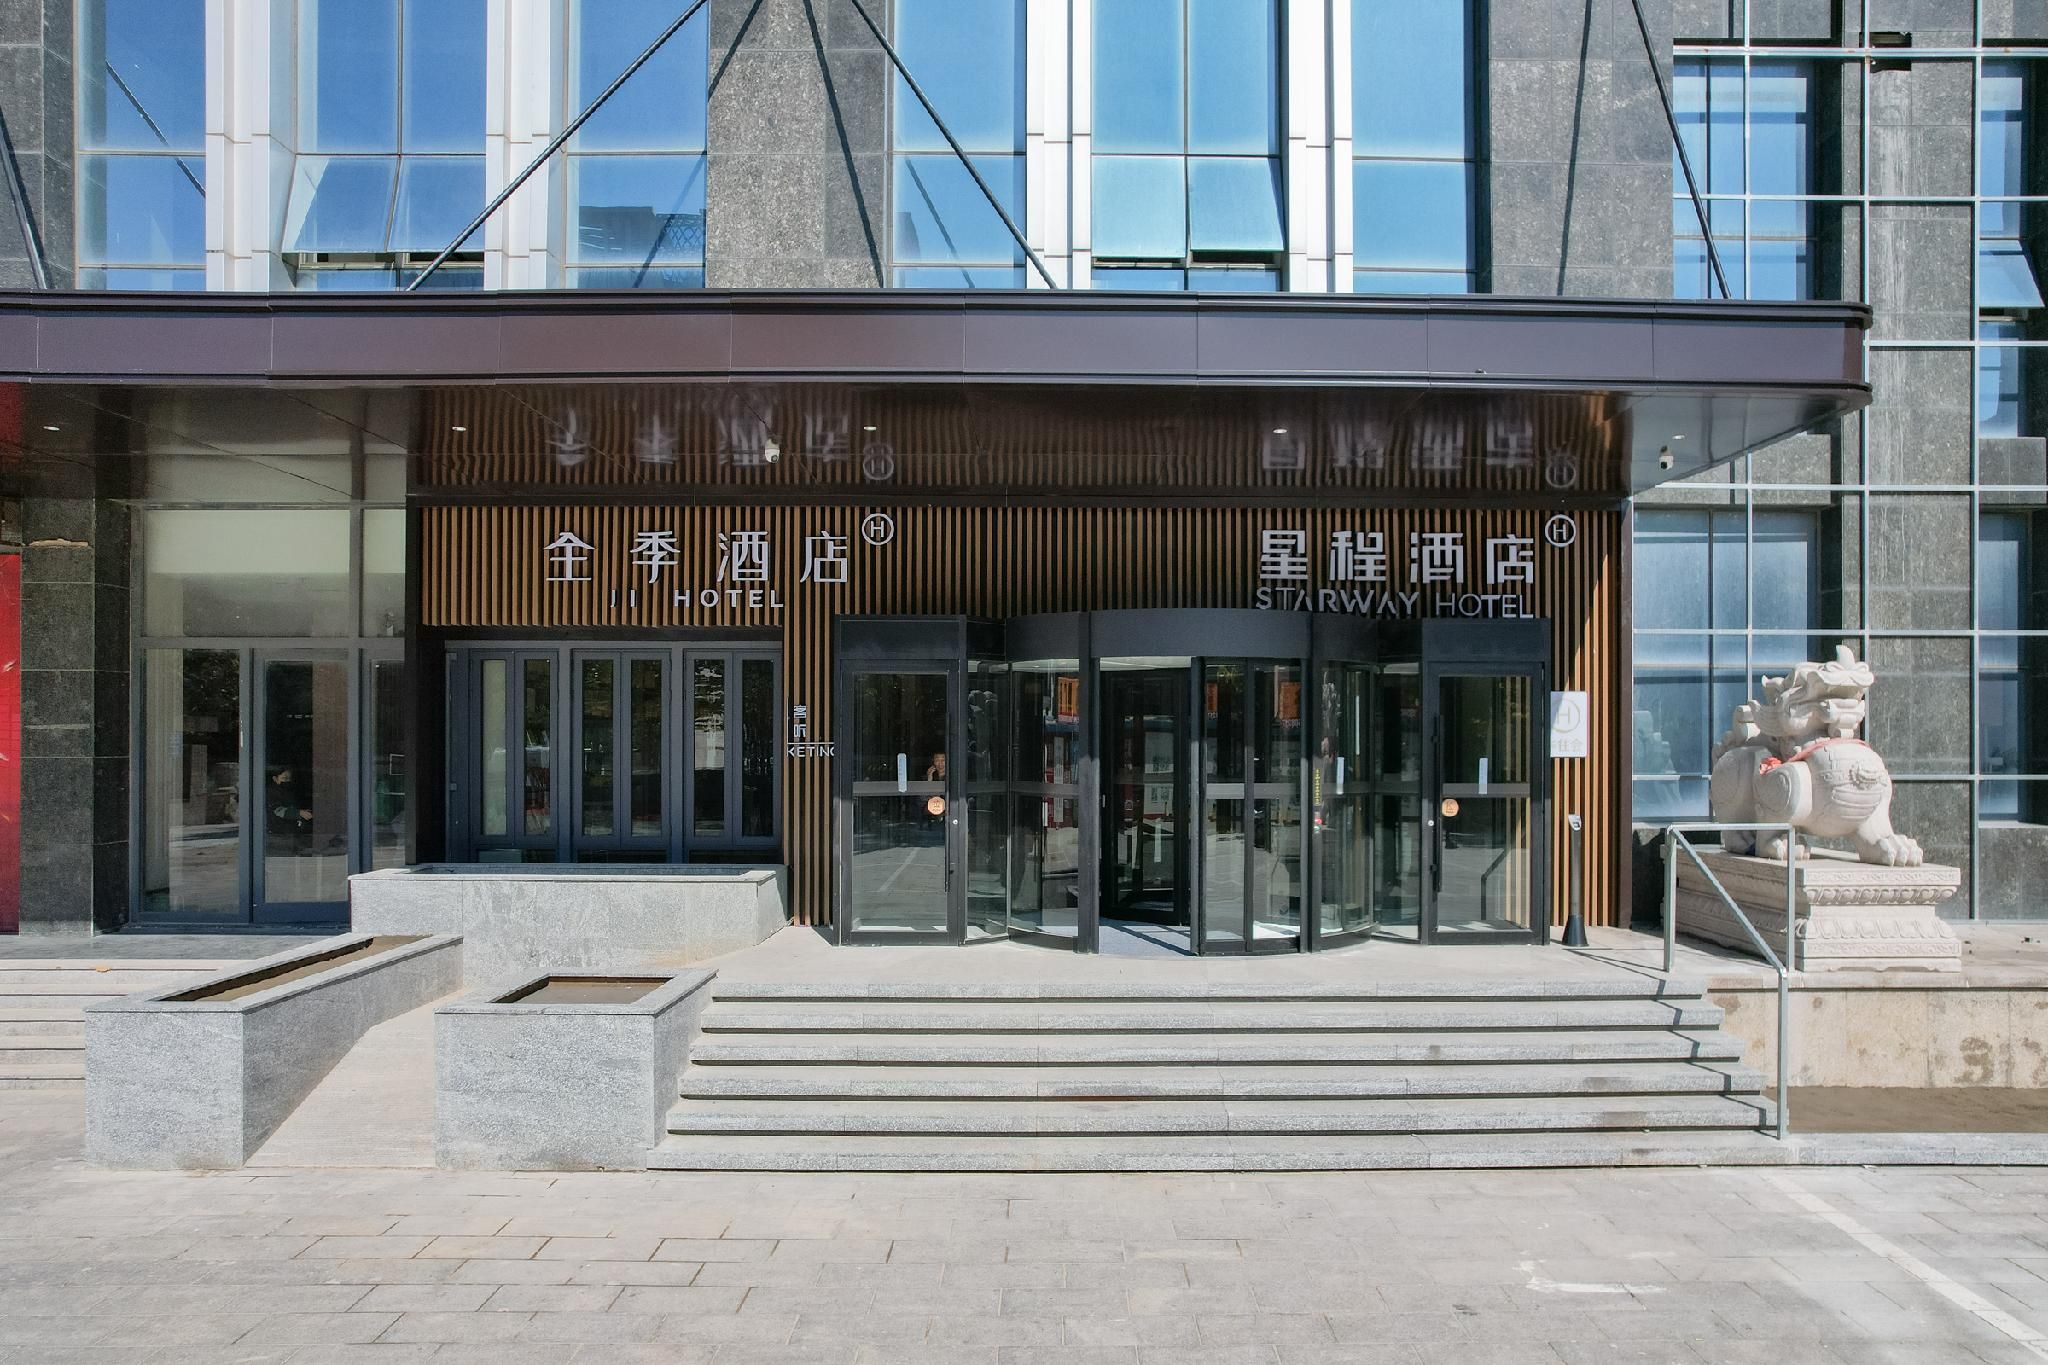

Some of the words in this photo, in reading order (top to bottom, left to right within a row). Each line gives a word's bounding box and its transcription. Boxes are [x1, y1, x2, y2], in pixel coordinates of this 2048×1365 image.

[544, 530, 848, 584] 全季酒店
[1259, 529, 1534, 585] 星程酒店
[674, 589, 784, 608] HOTEL
[1256, 587, 1420, 616] STARWAY
[1436, 594, 1534, 619] HOTEL
